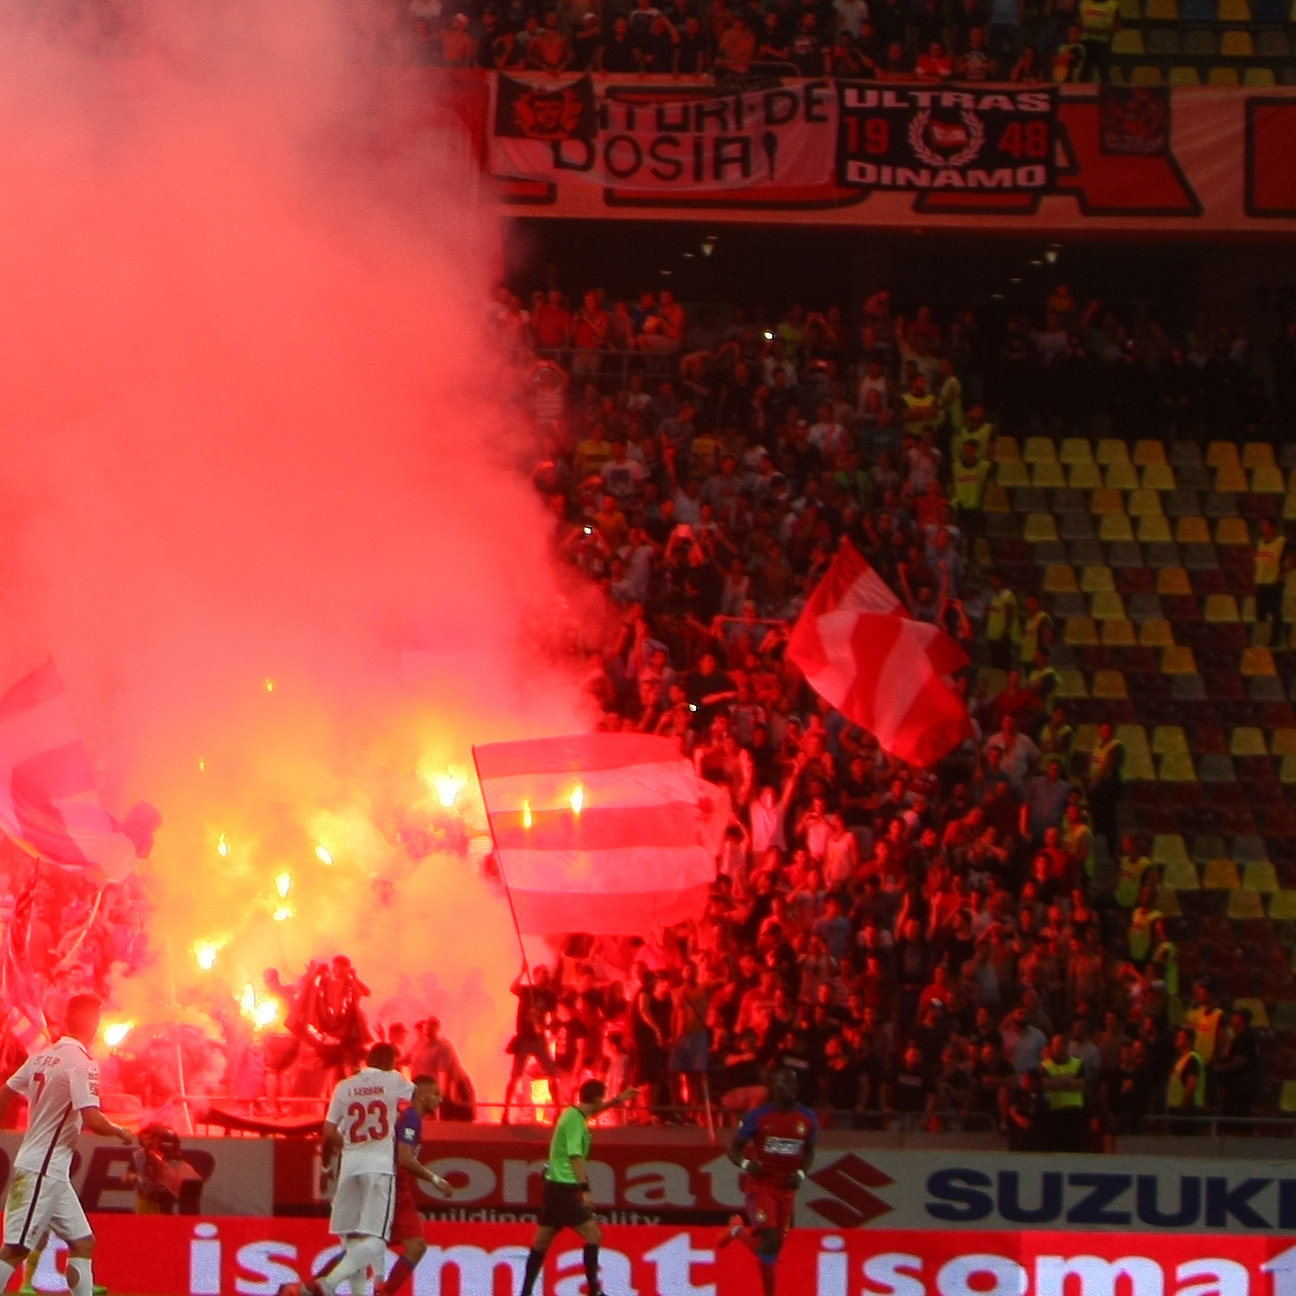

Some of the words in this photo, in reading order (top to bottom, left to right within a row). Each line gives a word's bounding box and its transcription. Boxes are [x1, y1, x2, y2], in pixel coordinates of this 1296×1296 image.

[844, 88, 1051, 113] ULTRAS
[845, 116, 890, 154] 19
[998, 120, 1049, 159] 48
[847, 159, 1048, 189] DINAMO
[348, 1100, 389, 1143] 23
[594, 1210, 662, 1225] ality
